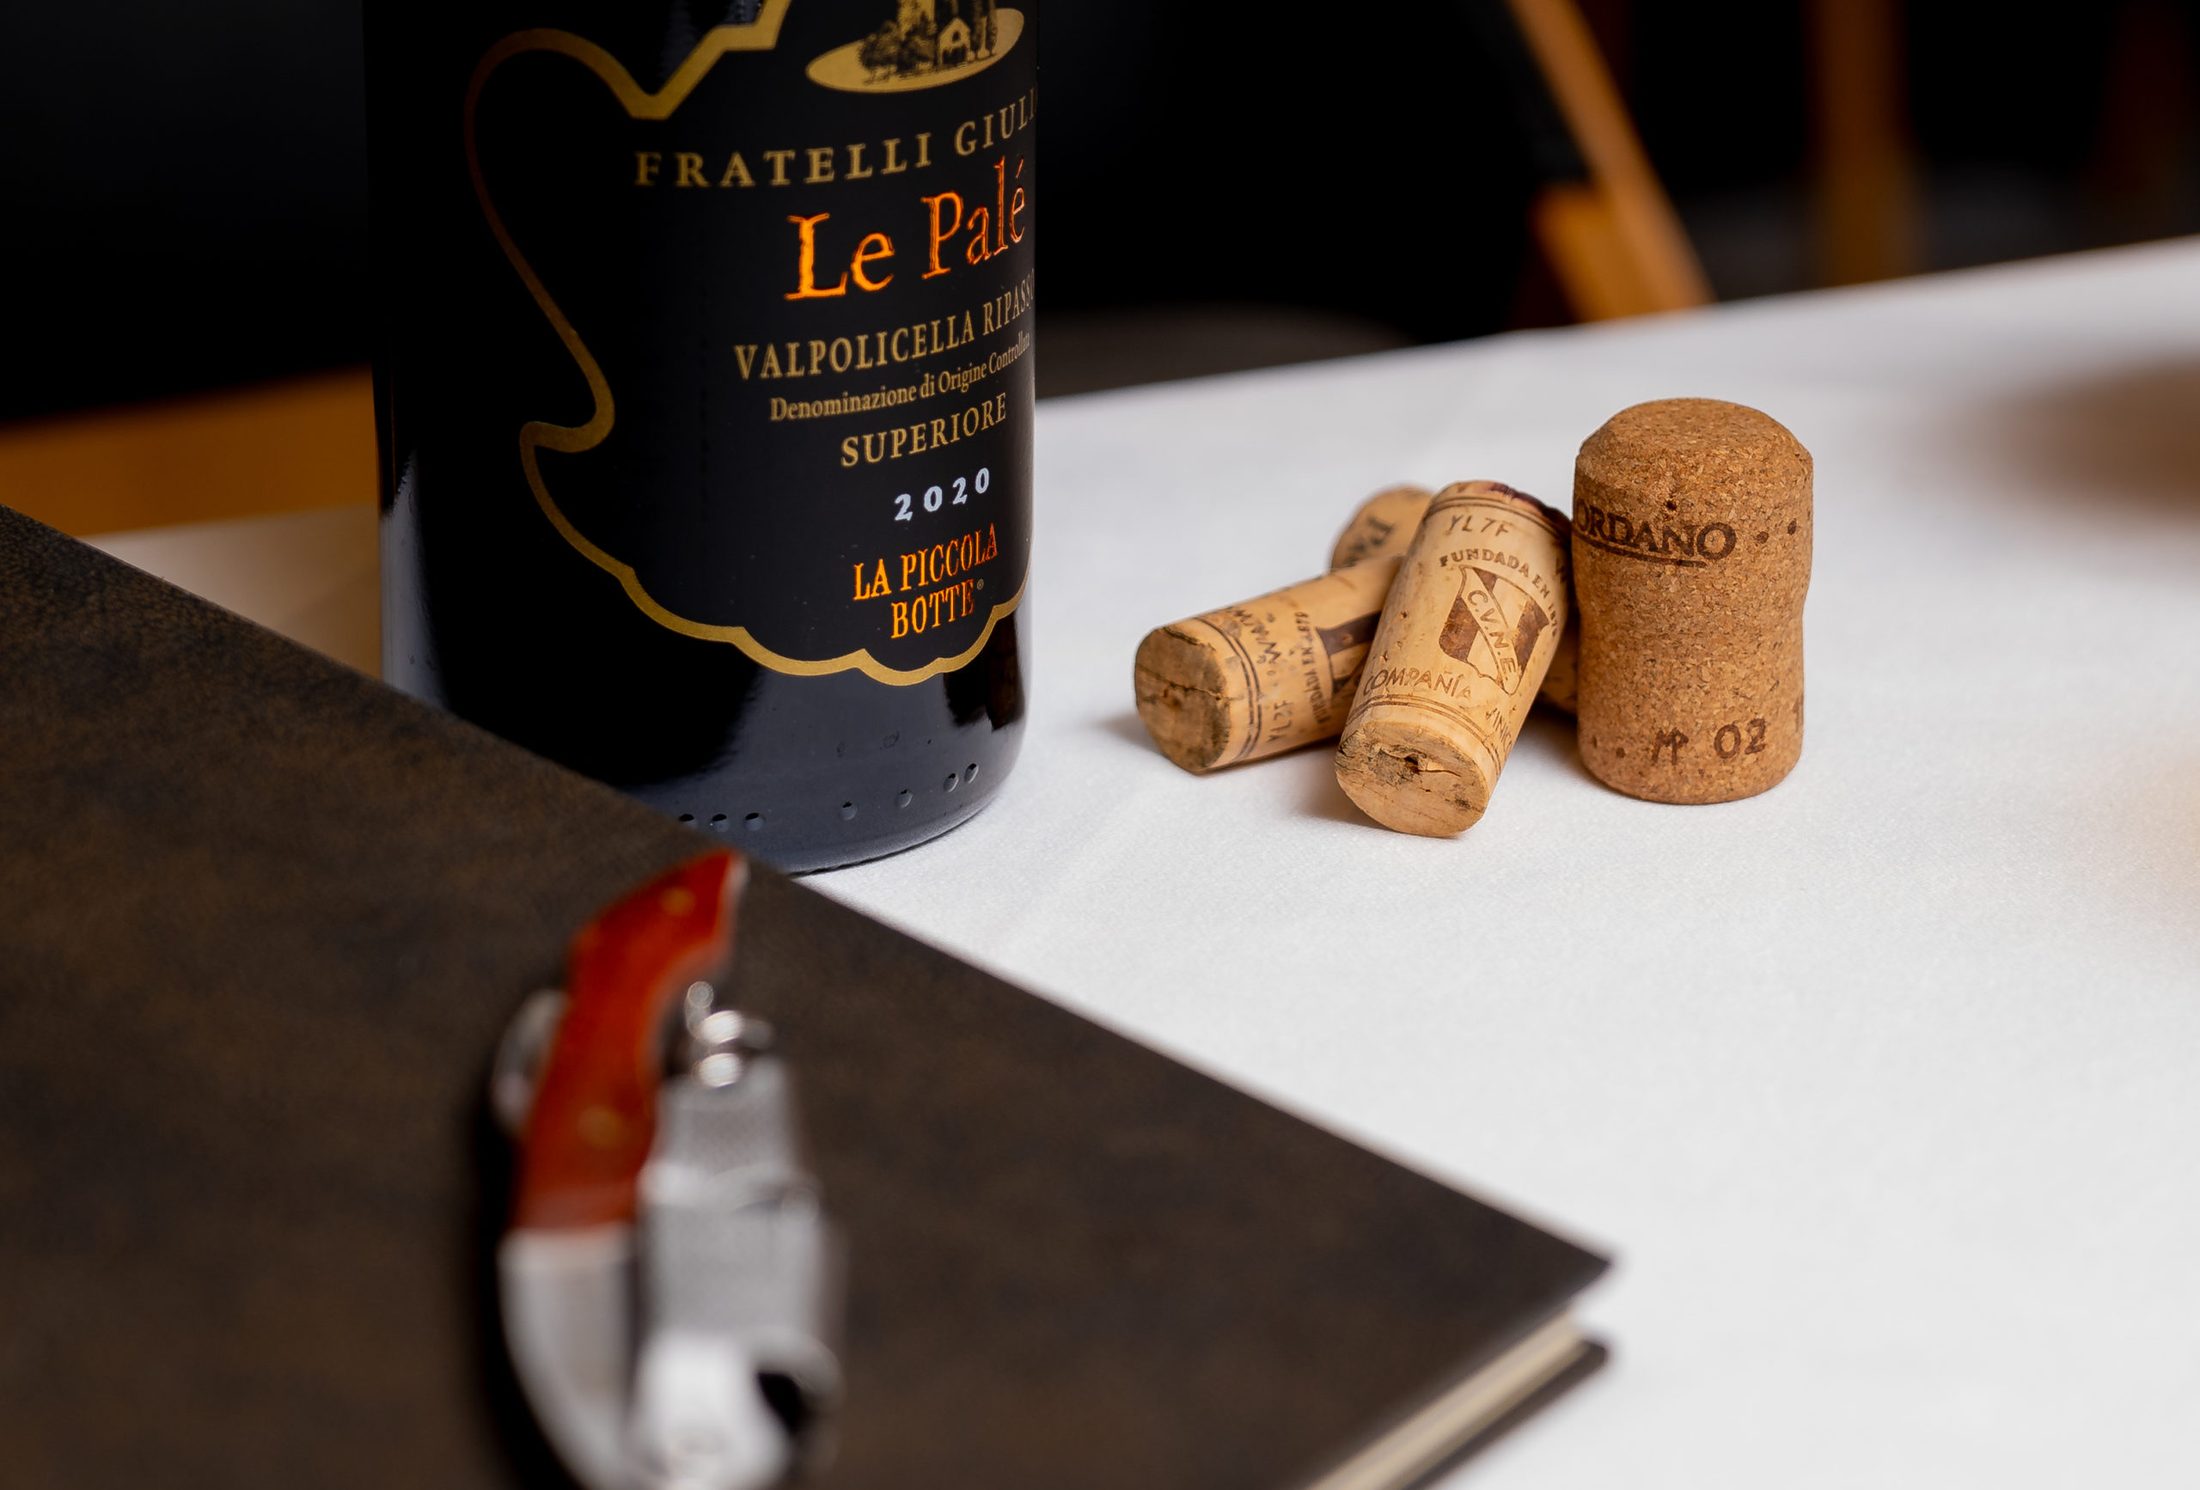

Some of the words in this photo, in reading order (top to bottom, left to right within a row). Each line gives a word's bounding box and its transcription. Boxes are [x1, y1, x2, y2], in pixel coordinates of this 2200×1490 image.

[635, 132, 932, 188] FRATELLI
[784, 212, 896, 300] Le
[921, 154, 1027, 280] Palé
[733, 310, 975, 381] VALPOLICELLA
[769, 385, 917, 422] Denominazione
[919, 372, 936, 399] di
[938, 362, 988, 394] Origine
[840, 391, 1007, 467] SUPERIORE
[894, 467, 990, 522] 2020
[852, 557, 892, 601] LA
[899, 522, 998, 592] PICCOLA
[1440, 548, 1530, 578] FUNDADA
[890, 578, 975, 640] BOTTE
